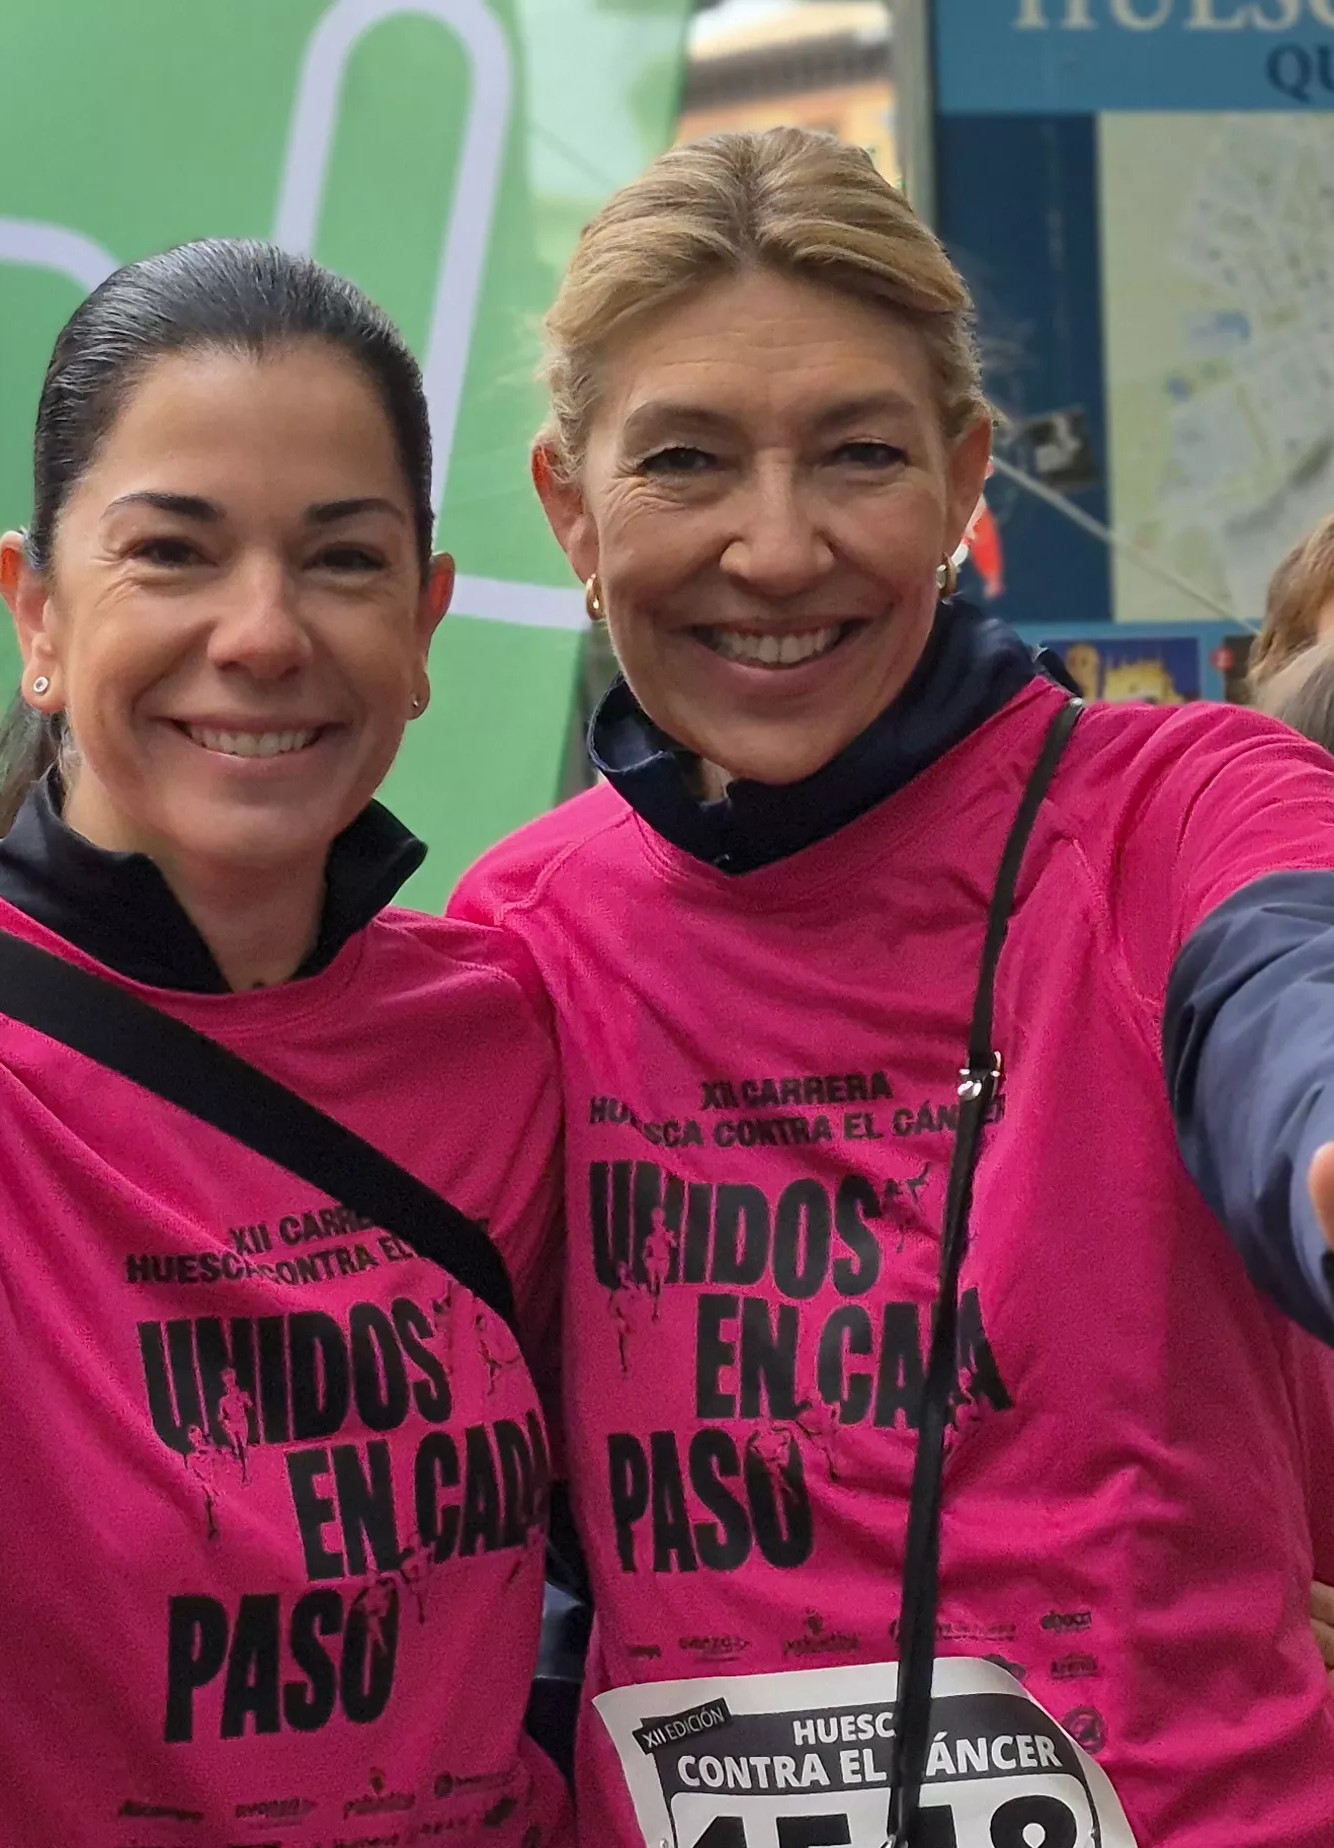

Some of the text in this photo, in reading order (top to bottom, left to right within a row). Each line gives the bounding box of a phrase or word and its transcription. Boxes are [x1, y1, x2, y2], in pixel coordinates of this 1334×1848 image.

[741, 1070, 895, 1108] CARRERA
[589, 1095, 704, 1148] HUSCA
[712, 1114, 833, 1149] CONTRA
[843, 1111, 884, 1141] EL
[230, 1205, 375, 1257] XII CARR
[379, 1234, 418, 1262] EL
[589, 1159, 884, 1300] UNIDOS
[136, 1297, 453, 1456] UNIDOS
[696, 1286, 1014, 1430] EN CAA
[285, 1438, 400, 1583] EN
[607, 1427, 815, 1575] PASO
[163, 1587, 402, 1744] PASO
[641, 1707, 725, 1749] XII EDICIÓN
[792, 1711, 896, 1746] HUESC
[677, 1731, 1064, 1789] CONTRA EL ÁNCER
